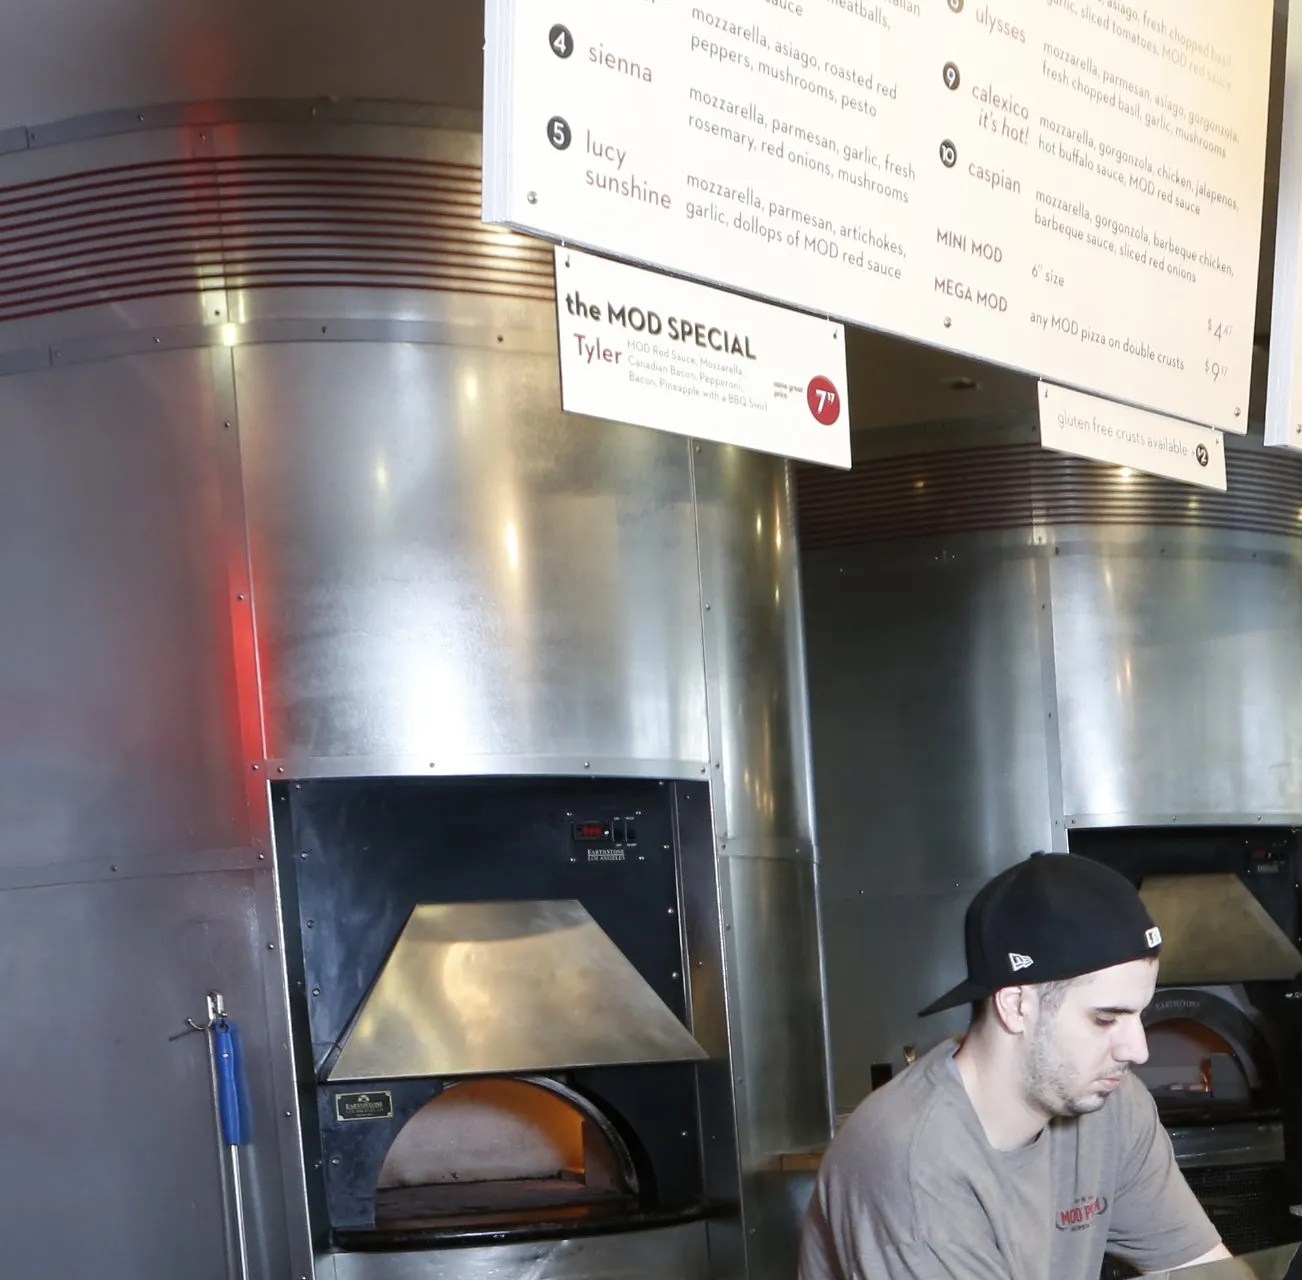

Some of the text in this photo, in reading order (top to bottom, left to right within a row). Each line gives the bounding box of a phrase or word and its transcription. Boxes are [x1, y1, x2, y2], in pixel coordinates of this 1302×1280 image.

[826, 0, 891, 31] eatballs,
[975, 5, 1026, 44] ulysses
[1143, 9, 1210, 58] fresh chopped
[589, 44, 652, 83] sienna
[692, 7, 898, 100] mozzarella, asiago, roasted red
[1080, 6, 1110, 31] sliced
[1162, 44, 1187, 68] MOD
[1188, 59, 1205, 78] red
[691, 34, 876, 118] peppers, mushrooms, pesto
[1042, 40, 1100, 78] mozzarella,
[1102, 68, 1152, 103] parmesan,
[1154, 93, 1186, 120] asiago,
[972, 81, 1029, 121] calexico
[1041, 60, 1068, 86] fresh
[1072, 76, 1116, 107] chopped
[1145, 111, 1173, 134] garlic,
[1175, 124, 1226, 160] mushrooms
[586, 130, 627, 170] lucy
[689, 86, 916, 182] mozzarella, parmesan, garlic, fresh
[1001, 120, 1030, 146] hot!
[688, 112, 909, 204] rosemary, red onions, mushrooms
[968, 162, 1021, 196] caspian
[1038, 133, 1201, 215] hot buffalo sauce, MOD red sauce
[1039, 115, 1240, 213] mozzarella, gorgonzola, chicken, jalapenos,
[585, 167, 672, 210] sunshine
[686, 172, 908, 260] mozzarella, parmesan, artichokes,
[1036, 189, 1235, 279] mozzarella, gorgonzola, barbeque chicken,
[685, 201, 903, 281] garlic, dollops of MOD red sauce
[936, 225, 1003, 263] MINI MOD
[1034, 210, 1197, 283] barbeque sauce, sliced red onions
[934, 275, 1009, 313] MEGA MOD
[1044, 269, 1065, 288] size
[566, 290, 758, 360] the MOD SPECIAL
[573, 333, 623, 364] Tyler
[627, 339, 651, 354] MOD
[1029, 311, 1185, 372] any MOD pizza on double crusts
[628, 355, 668, 374] Canadian
[702, 388, 720, 402] with
[728, 393, 748, 408] BBQ
[1057, 408, 1188, 456] gluten free crusts available
